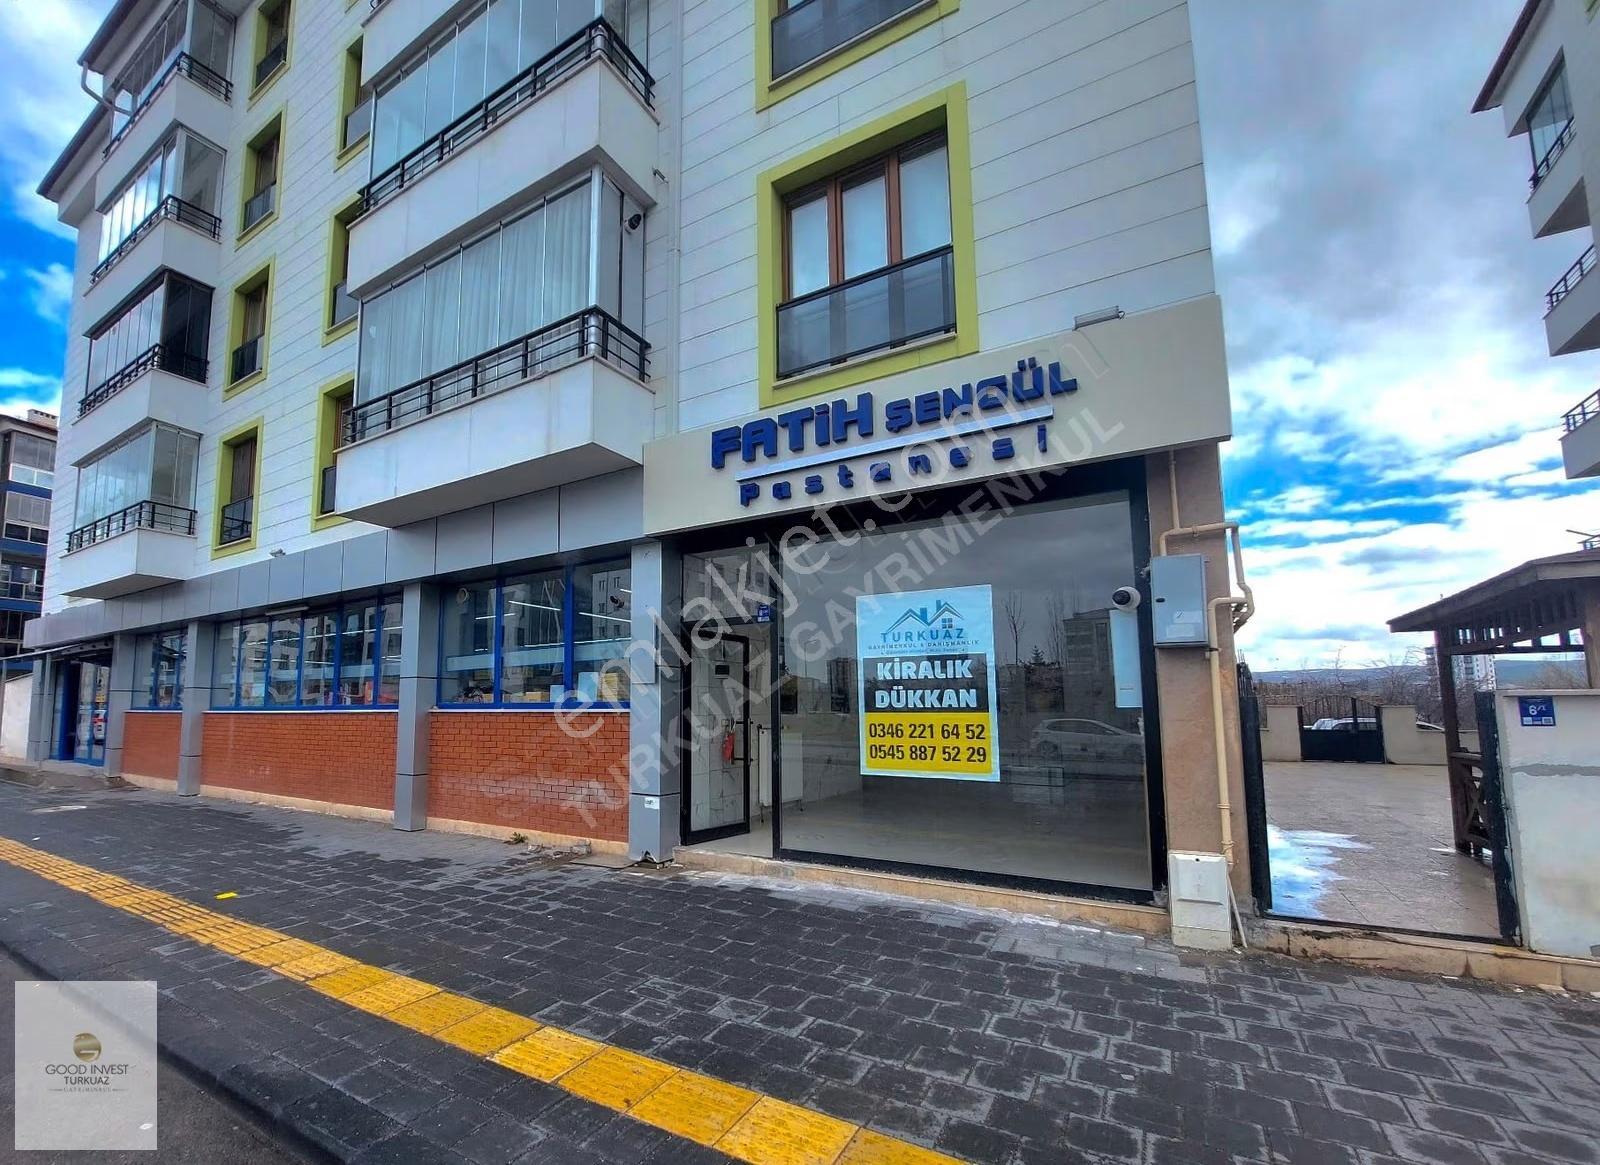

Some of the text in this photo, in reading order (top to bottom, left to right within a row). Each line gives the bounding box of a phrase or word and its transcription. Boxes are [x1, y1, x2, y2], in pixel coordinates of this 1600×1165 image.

[881, 628, 964, 643] TURKUAZ
[877, 658, 973, 680] KİRALIK
[875, 686, 978, 708] DÜKKAN
[869, 723, 986, 740] 0346 221 64 52
[870, 744, 986, 762] 0545 887 52 29
